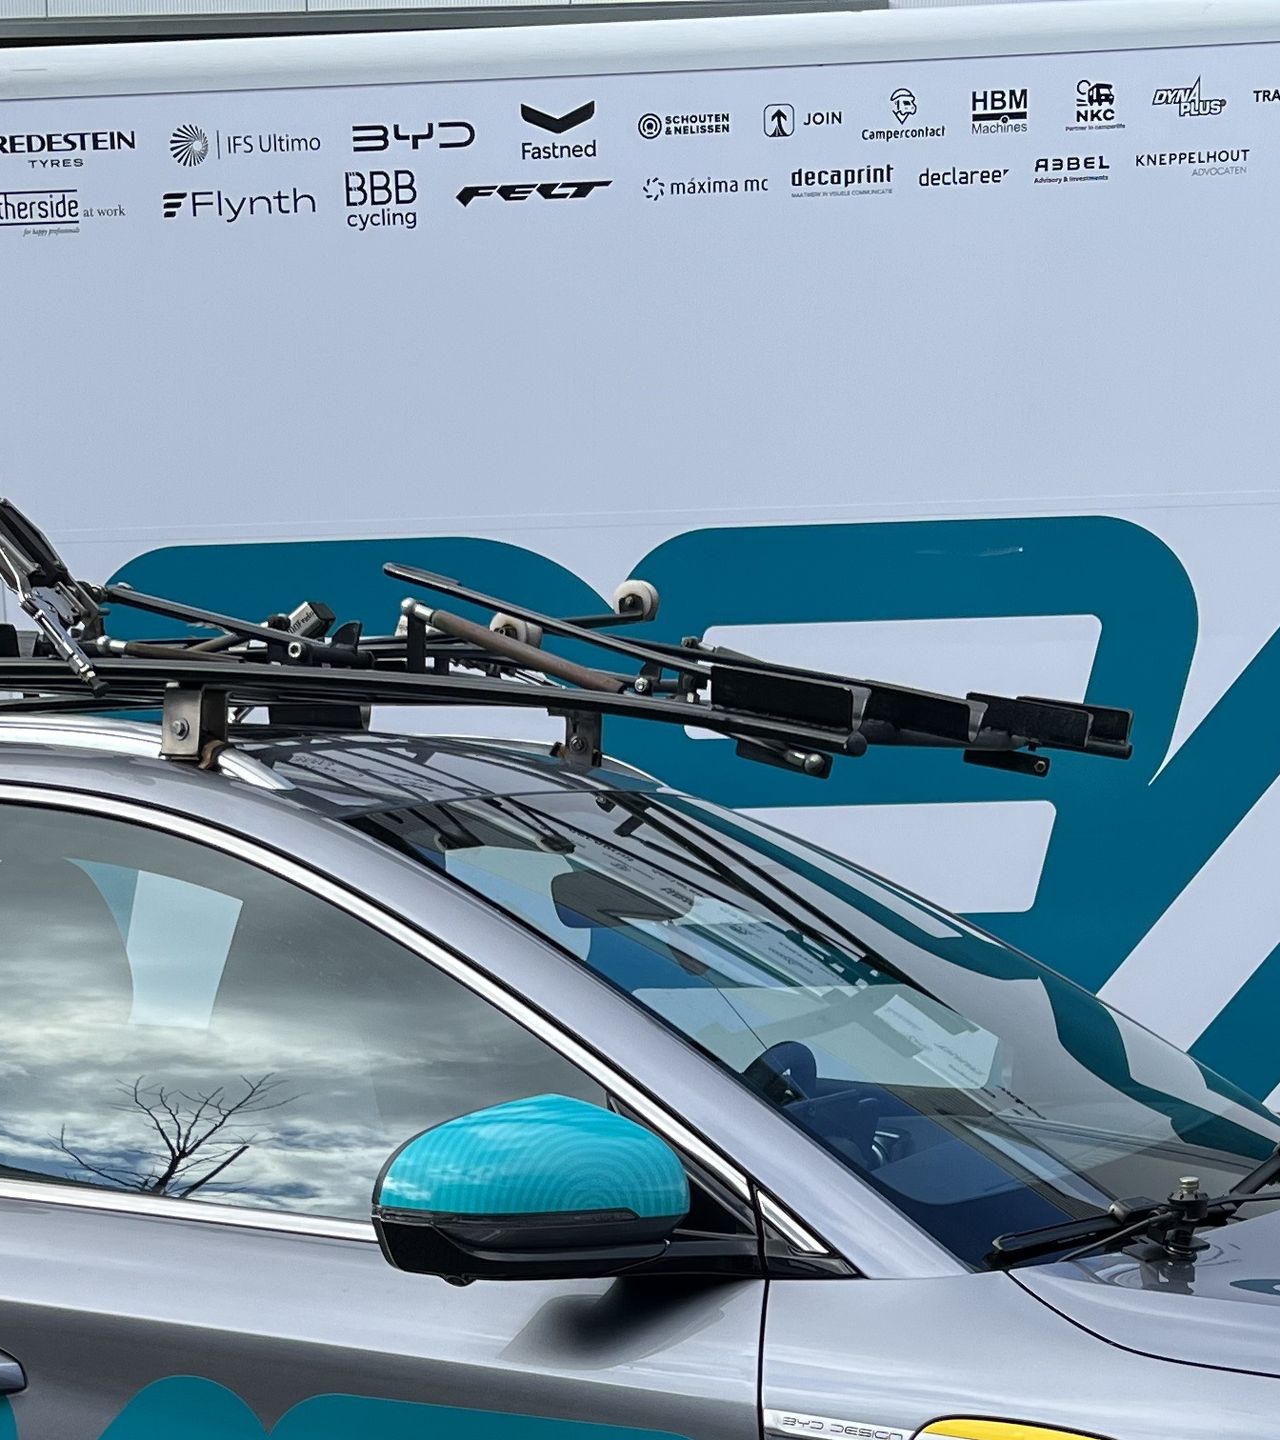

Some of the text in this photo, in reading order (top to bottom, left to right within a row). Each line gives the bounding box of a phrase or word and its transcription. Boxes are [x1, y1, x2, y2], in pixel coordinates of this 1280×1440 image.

[972, 89, 1028, 111] HBM
[665, 113, 730, 125] SCHOUTEN
[803, 112, 842, 126] JOIN
[1076, 109, 1115, 122] NKC
[352, 121, 476, 152] BYD
[665, 124, 730, 136] & NELISSEN
[862, 126, 946, 142] Campercontact
[971, 122, 1028, 136] Machines
[227, 134, 321, 154] IFS Ultimo
[521, 140, 597, 161] Fastned
[28, 158, 84, 169] TYRES
[1135, 149, 1250, 167] KNEPPELHOUT
[791, 164, 894, 188] decaprint
[1192, 166, 1247, 177] ADVOCATEN
[345, 169, 417, 207] BBB
[455, 180, 613, 207] FELT
[670, 176, 769, 195] máxima mc
[83, 205, 94, 217] at
[97, 204, 126, 216] work
[191, 187, 317, 223] Flynth
[347, 208, 417, 231] cycling
[782, 1415, 825, 1432] BYD
